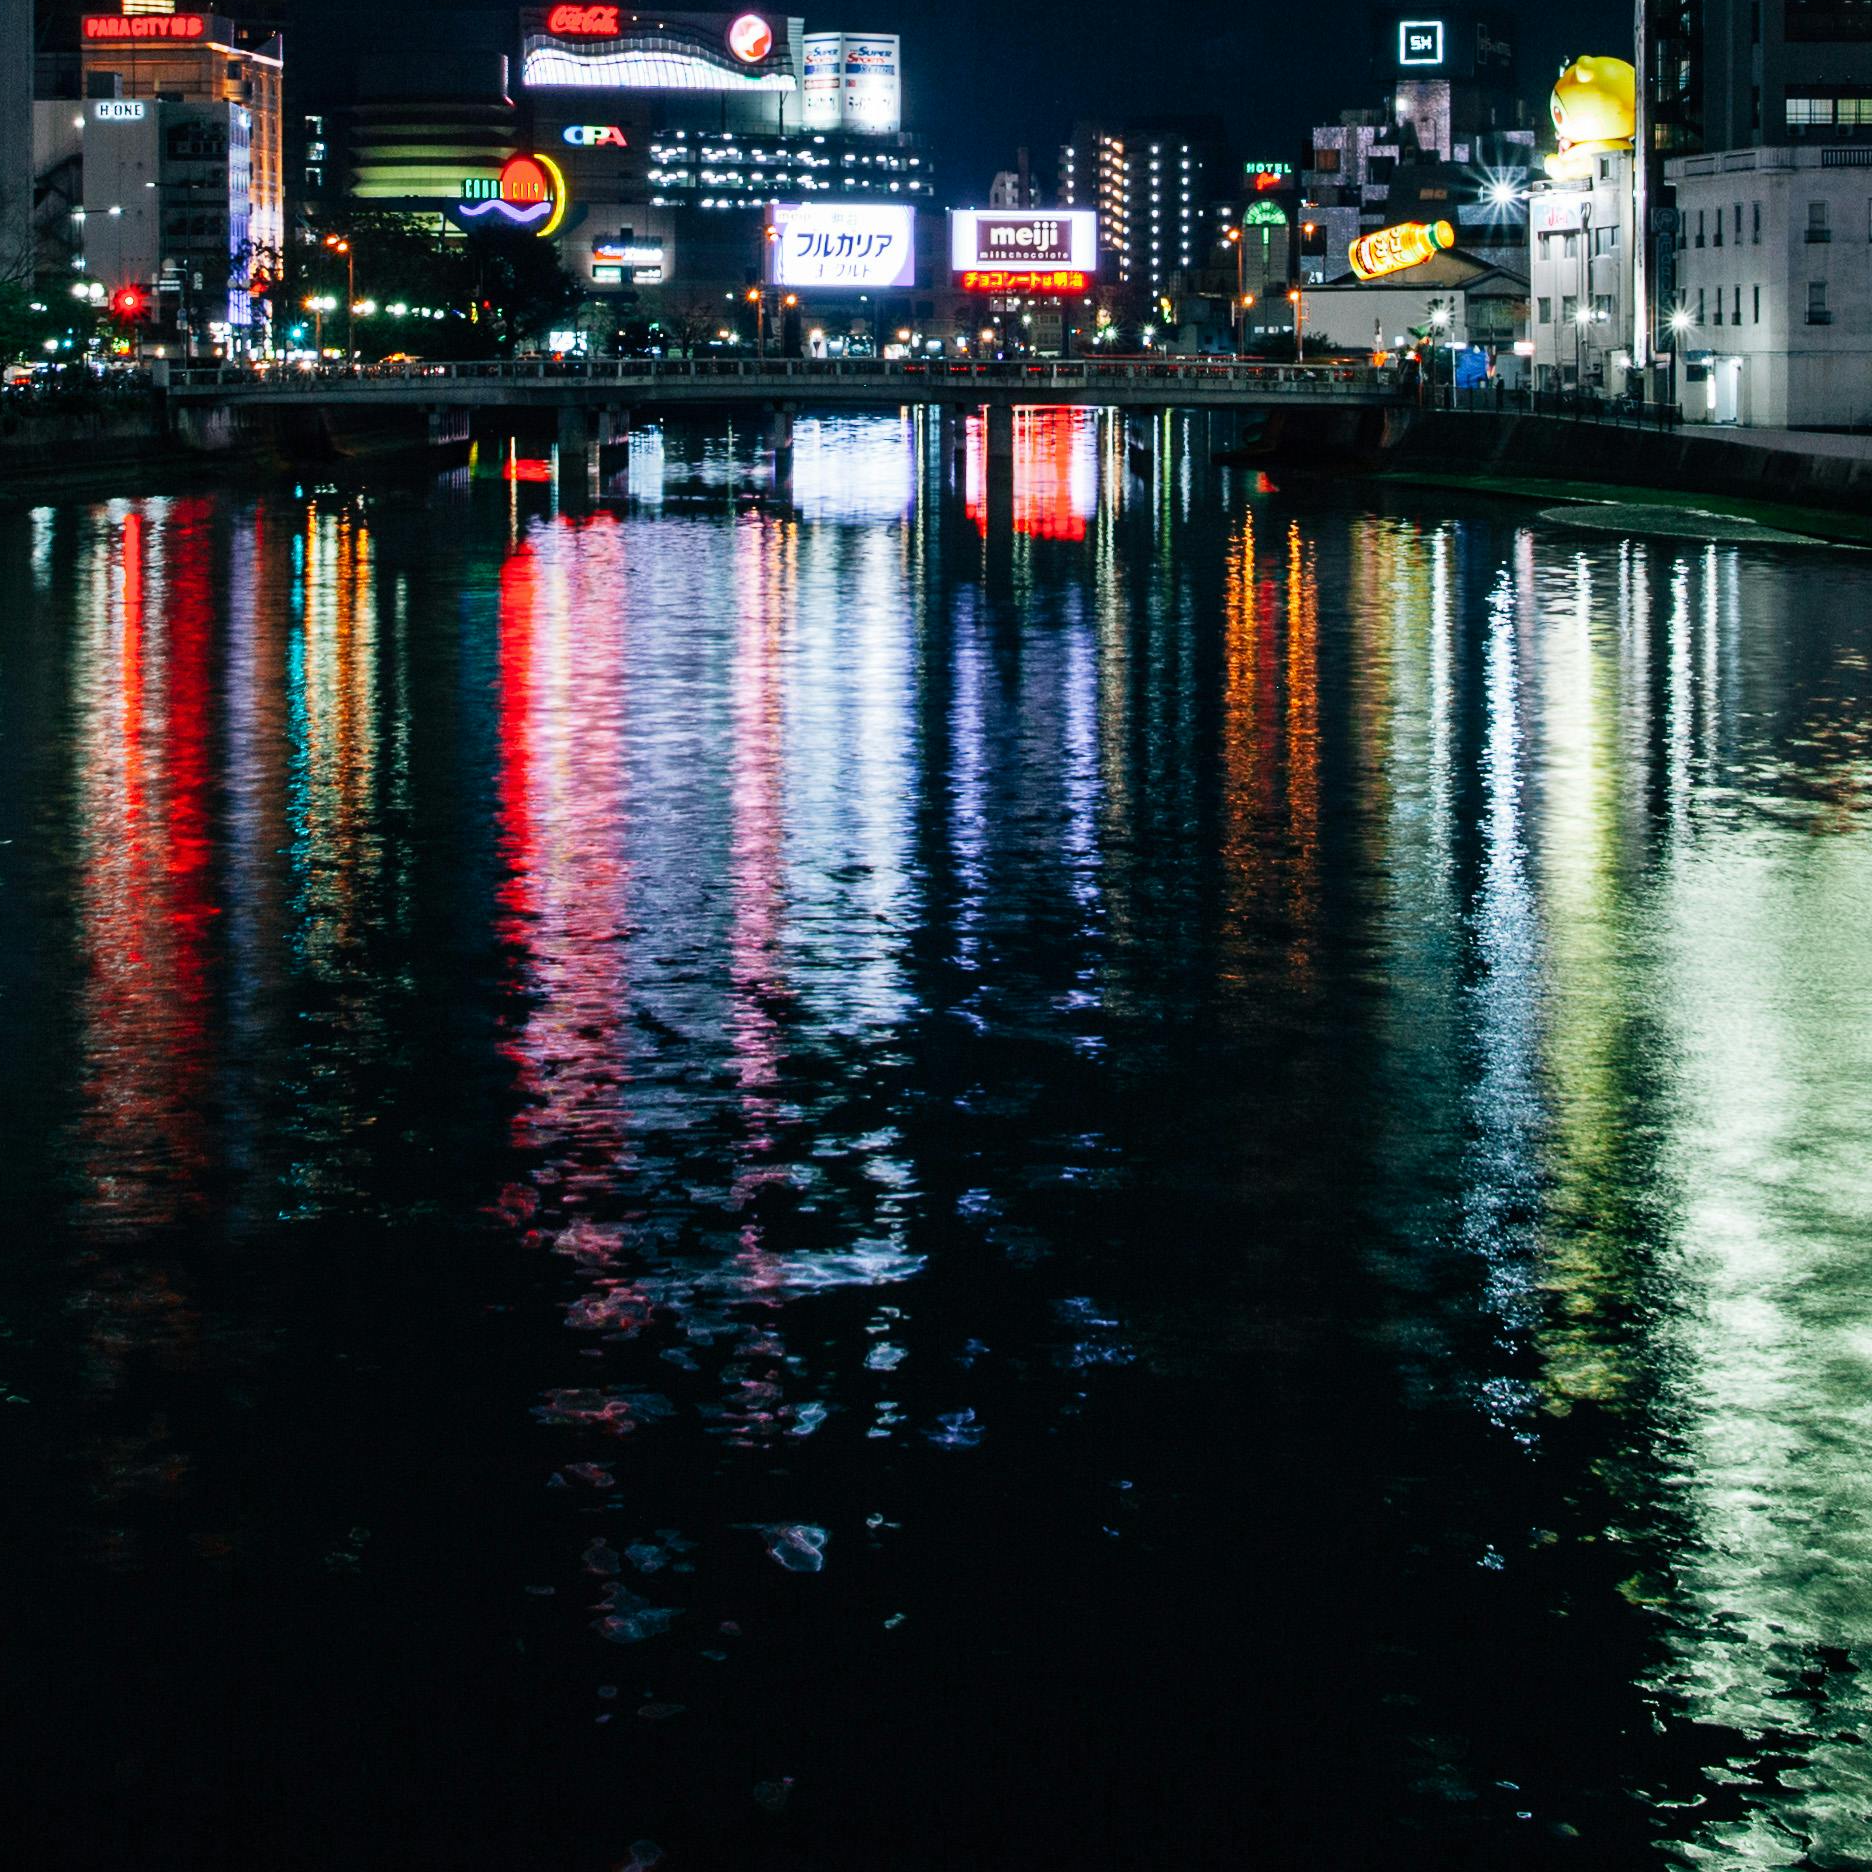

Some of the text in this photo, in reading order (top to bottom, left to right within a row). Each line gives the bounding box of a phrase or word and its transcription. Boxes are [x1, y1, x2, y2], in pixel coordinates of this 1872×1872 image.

[858, 46, 894, 58] SUPER
[562, 125, 628, 147] OPA
[1246, 162, 1292, 174] HOTEL
[512, 182, 540, 199] CITY
[796, 232, 893, 258] フルカリア
[989, 221, 1059, 252] meiji
